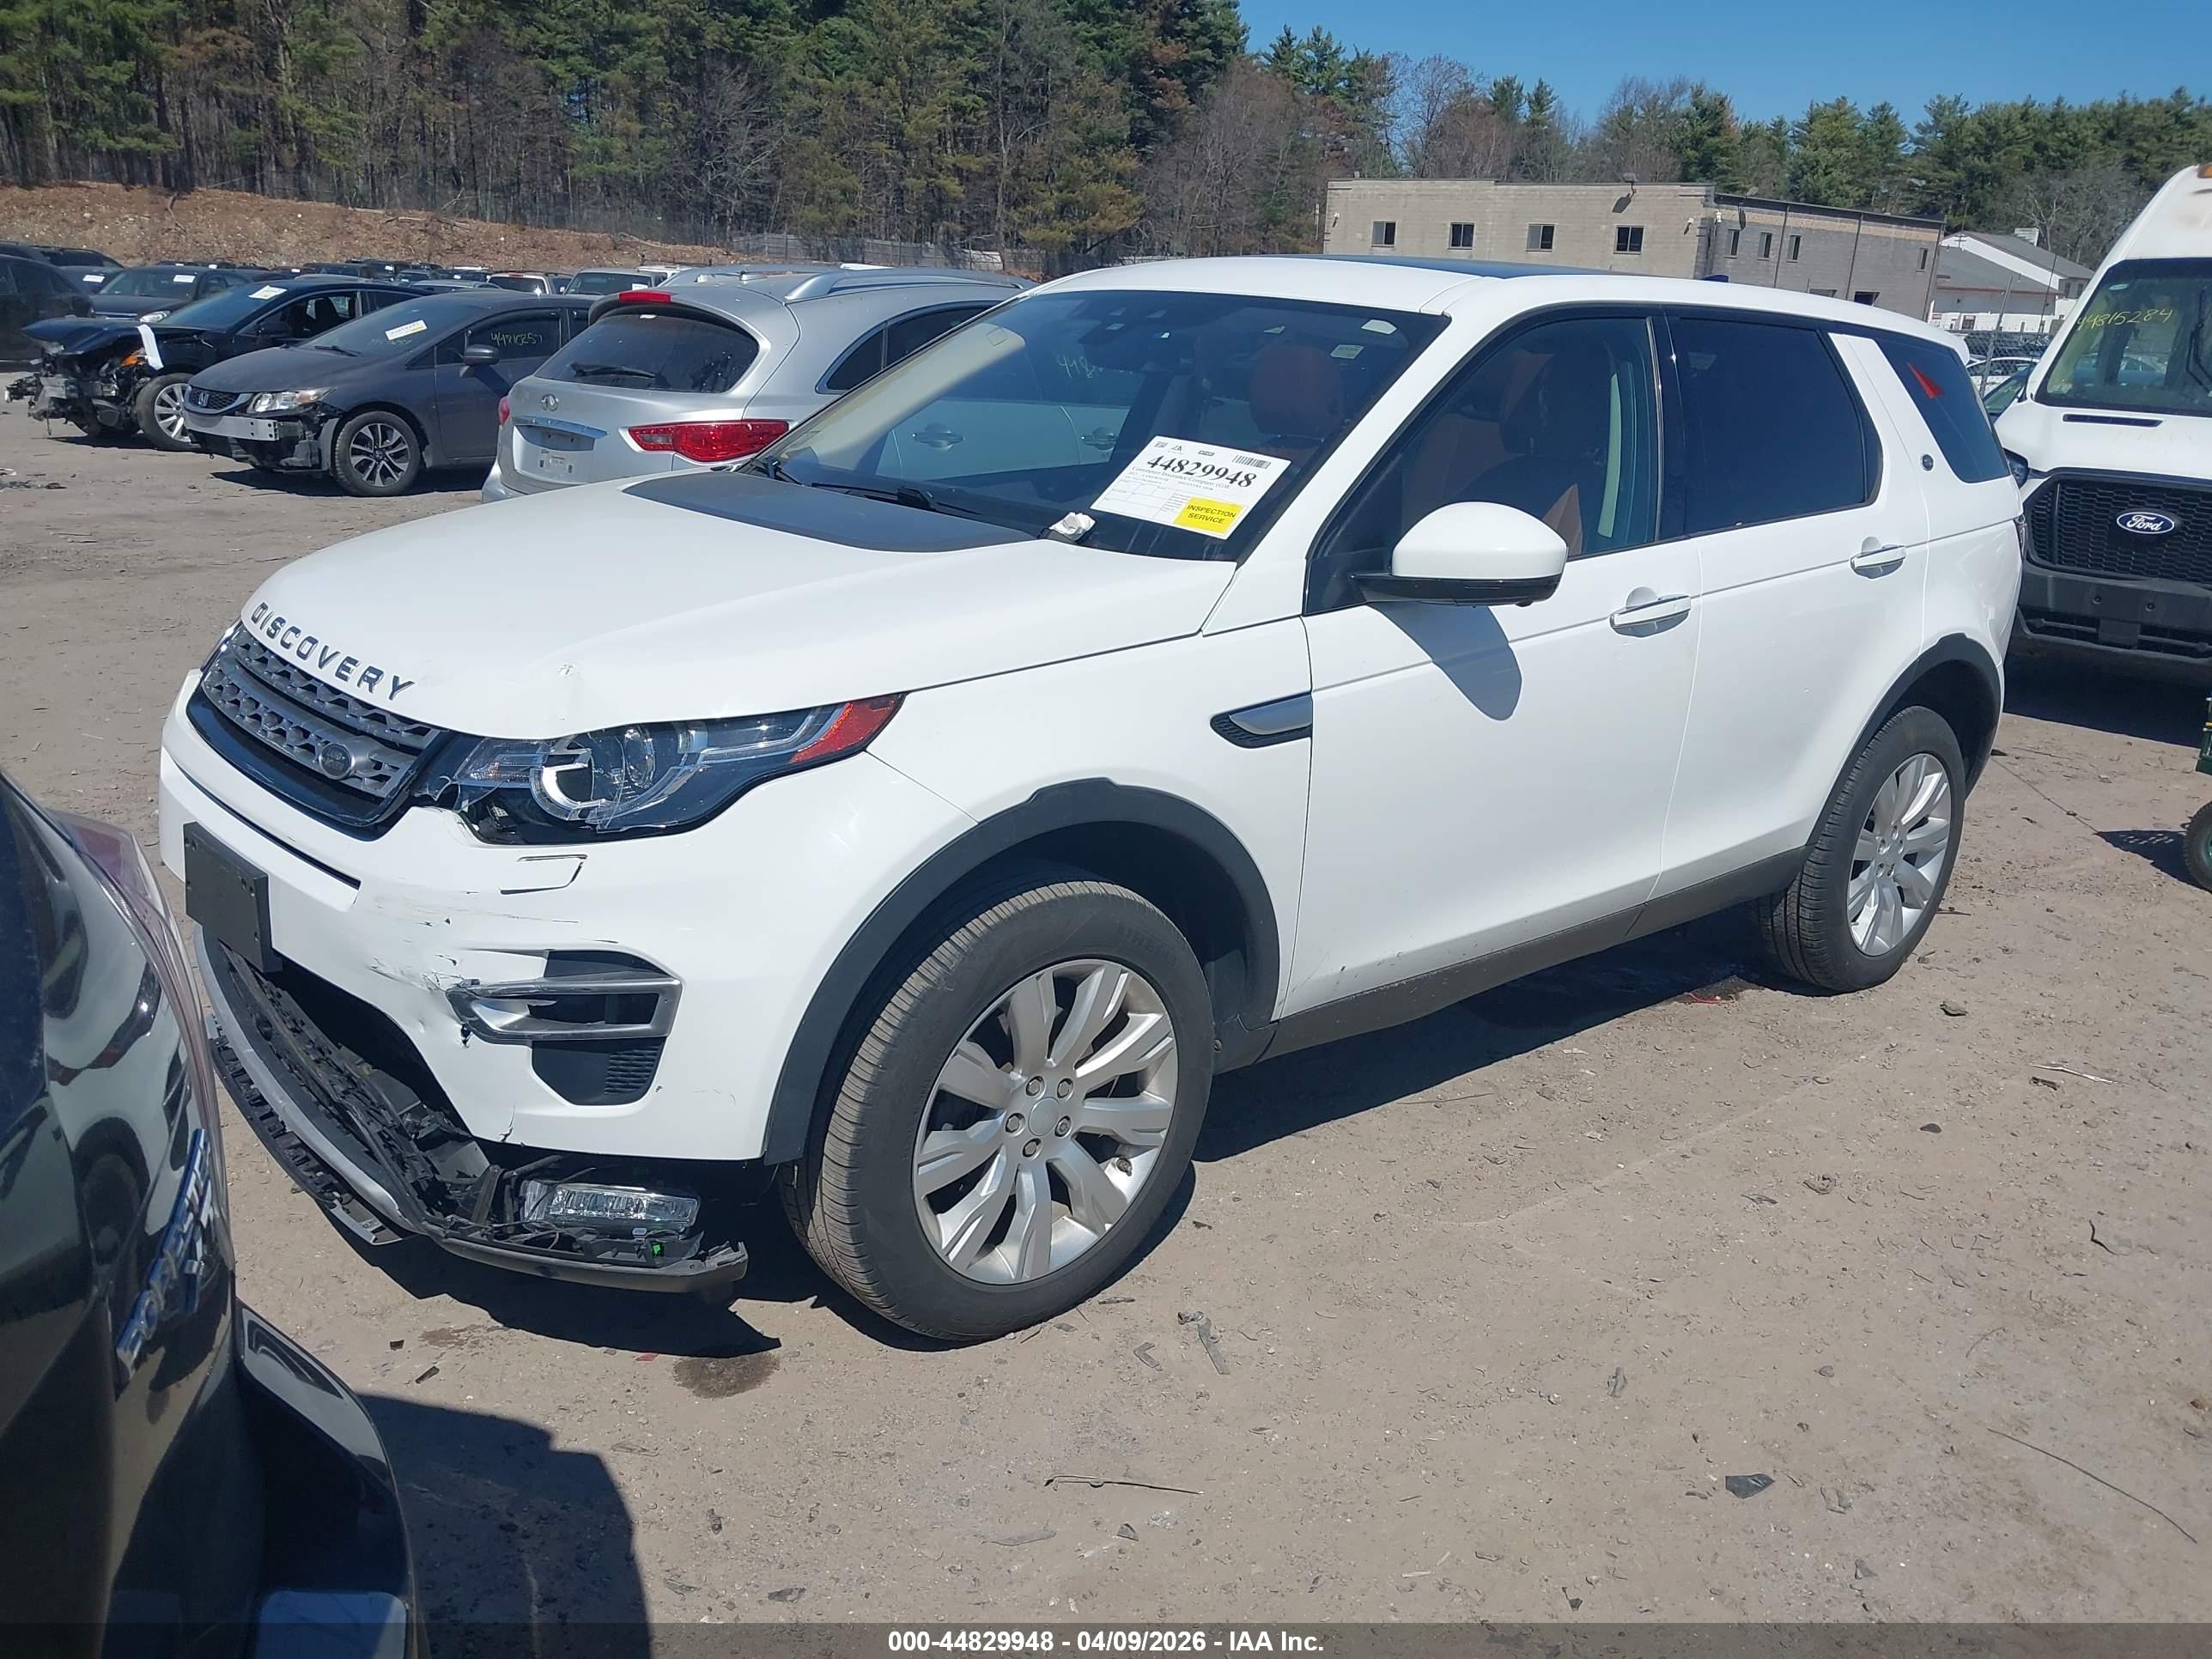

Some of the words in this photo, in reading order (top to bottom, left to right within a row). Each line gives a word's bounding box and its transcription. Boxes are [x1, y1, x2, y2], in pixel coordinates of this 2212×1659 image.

[2076, 309, 2172, 331] 44815284
[1147, 454, 1257, 488] 44829948
[1187, 504, 1237, 518] INSPECTION
[1188, 513, 1225, 524] SERVICE
[2126, 514, 2165, 531] Ford
[251, 601, 416, 701] DISCOVERY
